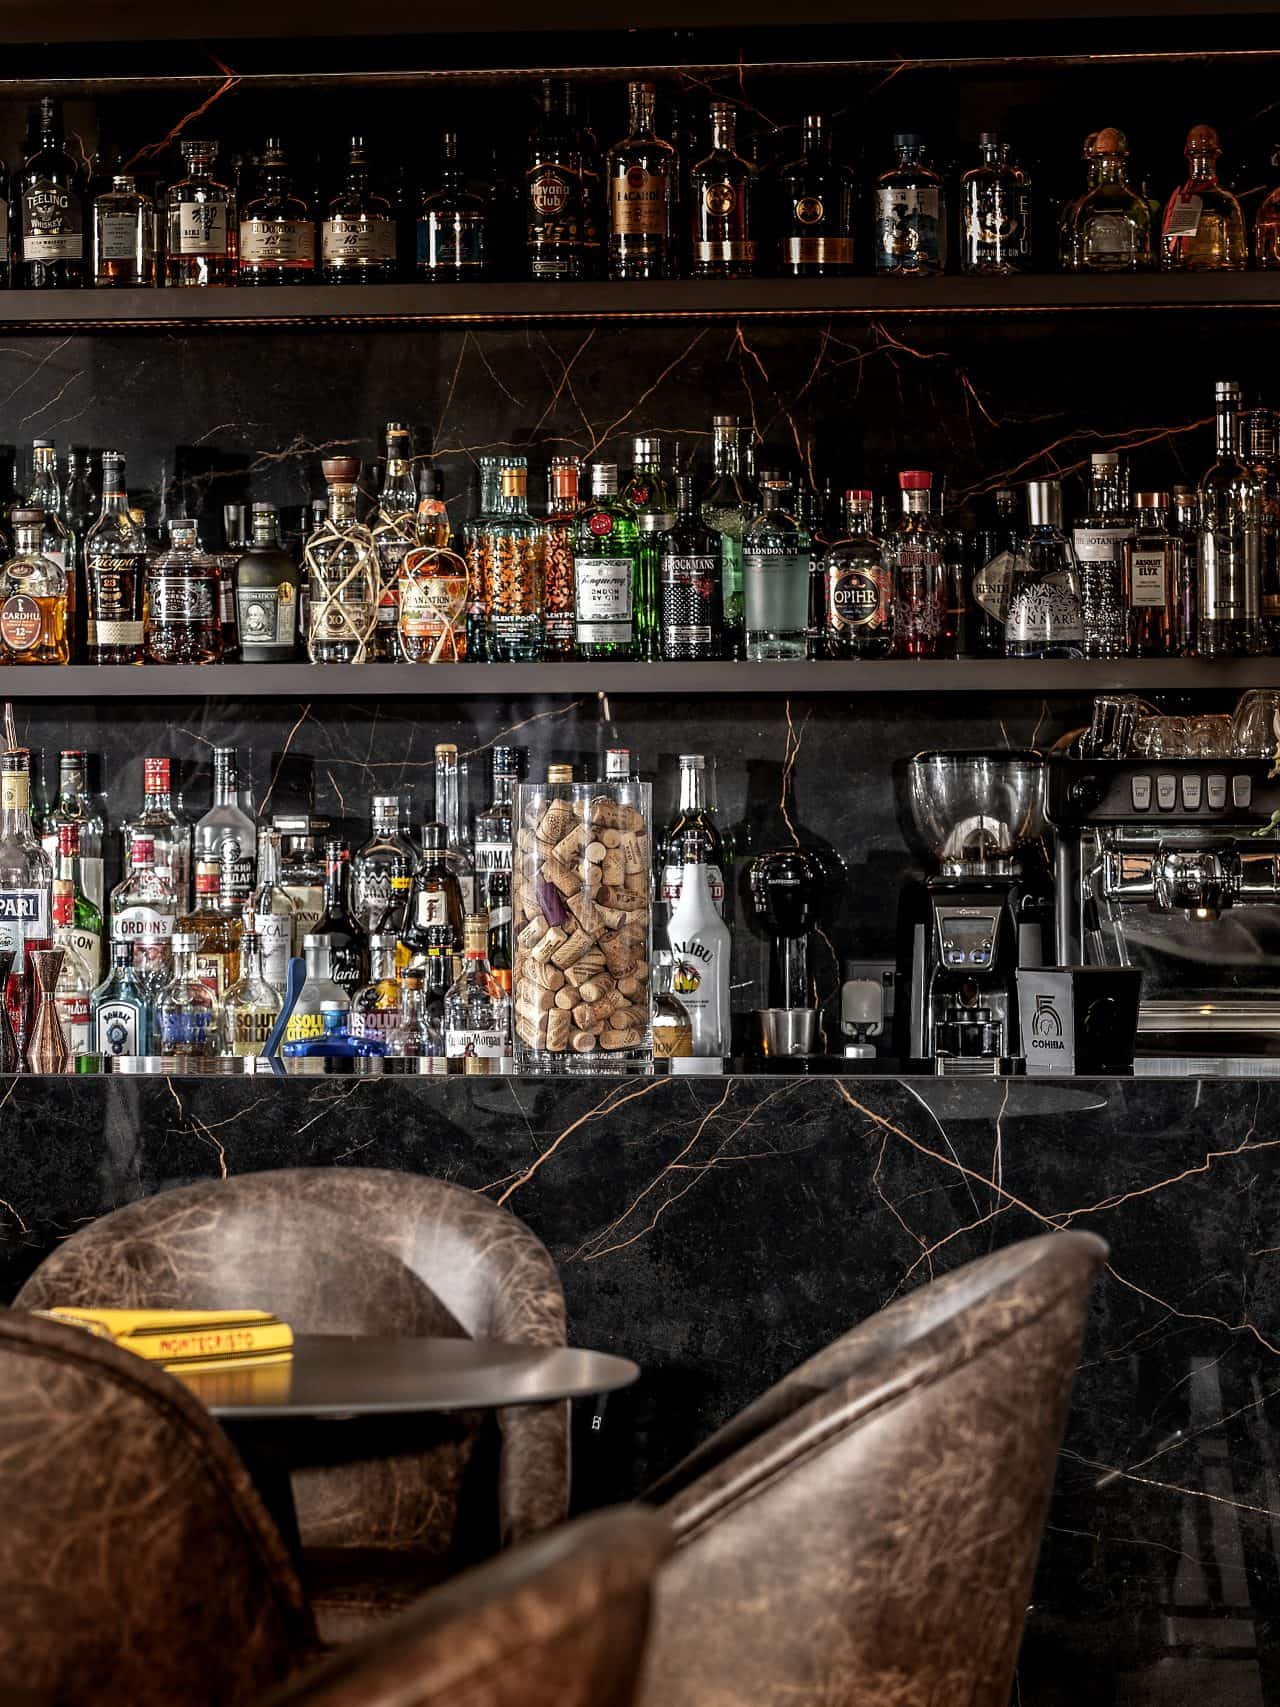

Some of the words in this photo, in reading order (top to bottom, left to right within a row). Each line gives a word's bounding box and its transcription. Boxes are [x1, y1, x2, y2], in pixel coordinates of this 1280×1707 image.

[530, 183, 570, 195] Havana
[27, 192, 69, 209] TEELING
[536, 195, 561, 207] Club
[30, 217, 63, 229] WHISKEY
[544, 222, 554, 236] 7
[752, 547, 784, 555] LONDON
[88, 555, 136, 571] Zacapa
[663, 558, 715, 571] BROCKMANS
[1138, 568, 1158, 576] ELYX
[834, 590, 877, 604] OPIHR
[2, 612, 41, 620] CARDHU
[328, 614, 344, 625] XO
[1015, 614, 1036, 625] GN
[15, 628, 26, 636] 12
[221, 862, 251, 873] ССКИЙ
[261, 925, 288, 937] ZCAL
[673, 940, 714, 963] ALIBU
[103, 1010, 131, 1024] BOMBAY
[236, 1013, 277, 1028] SOLUT
[287, 1014, 325, 1028] BSOLU
[287, 1028, 324, 1041] CITRO
[472, 1031, 501, 1047] Morgan
[1031, 1039, 1065, 1050] COHIBA
